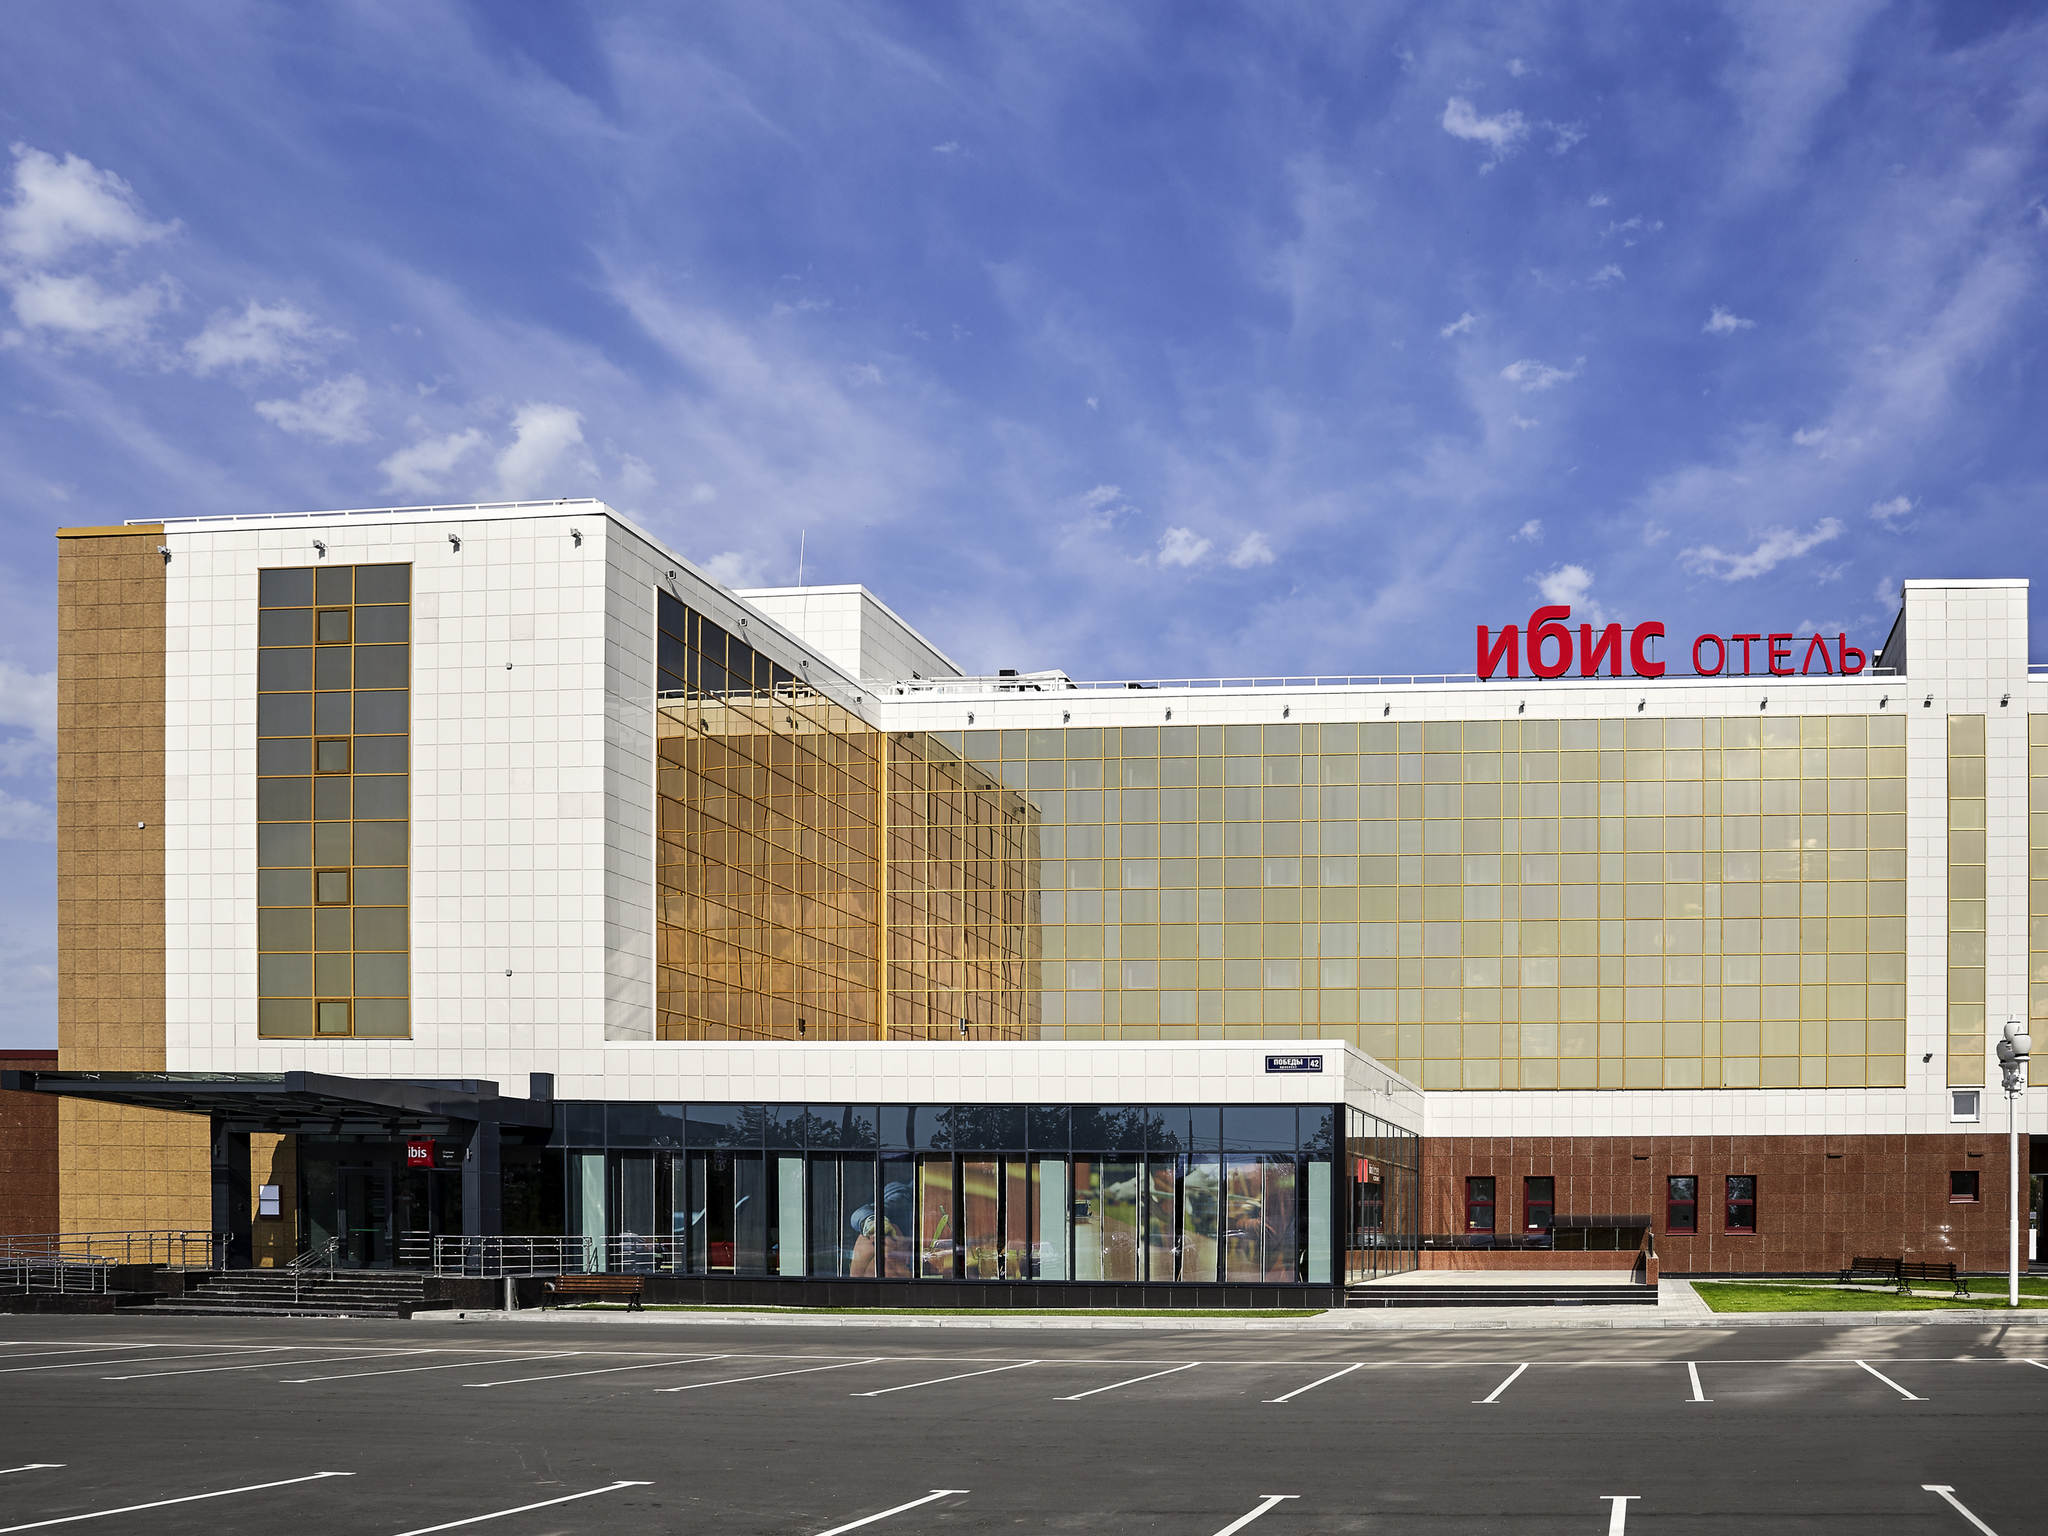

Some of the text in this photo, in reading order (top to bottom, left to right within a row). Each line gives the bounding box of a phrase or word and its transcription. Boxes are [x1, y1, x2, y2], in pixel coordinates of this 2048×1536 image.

[1477, 605, 1866, 679] ибис ОТЕЛЬ
[1310, 1059, 1319, 1067] 42
[408, 1146, 427, 1158] ibis
